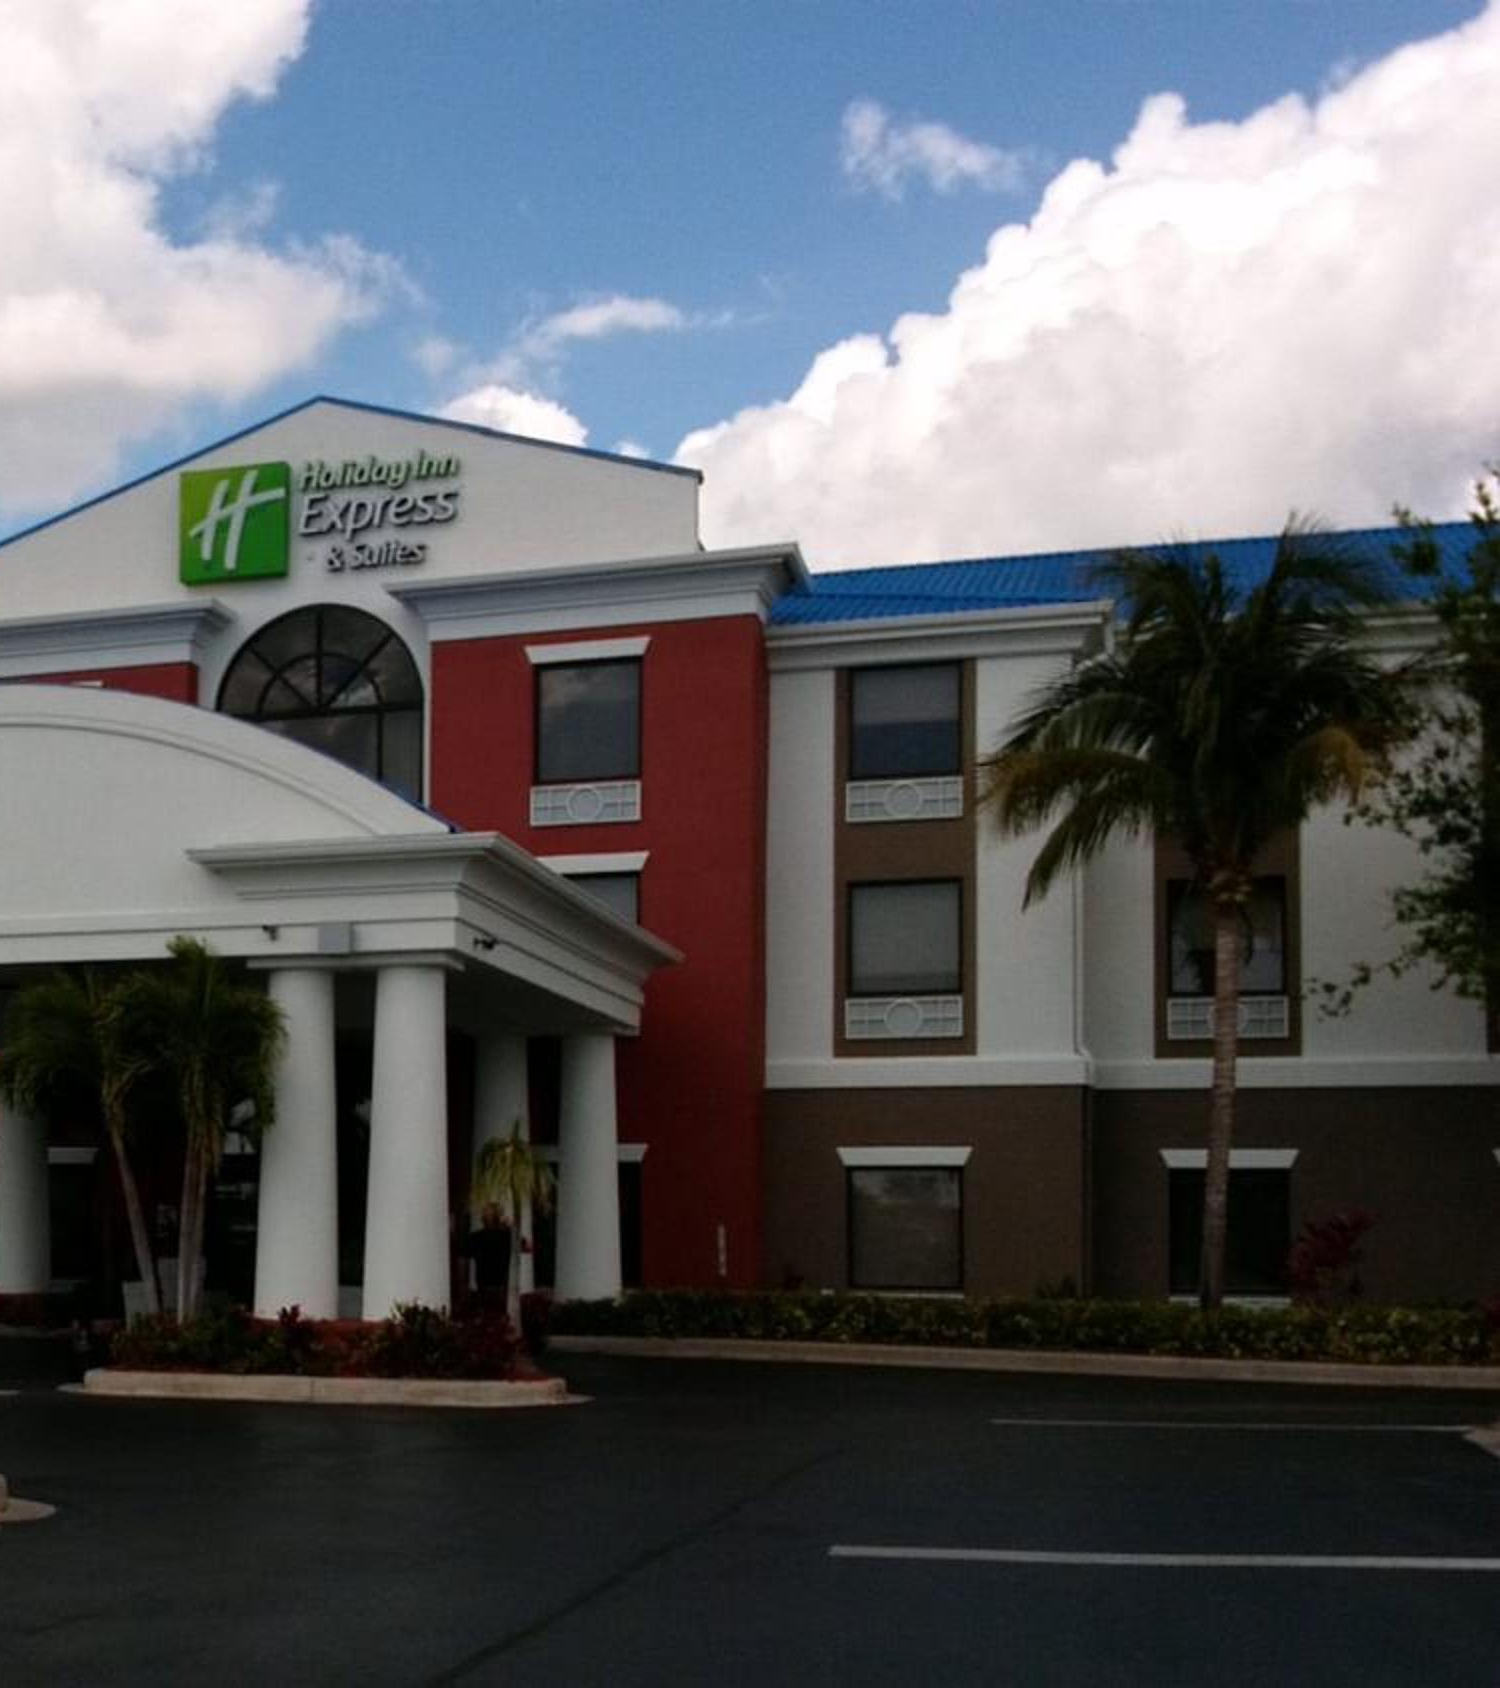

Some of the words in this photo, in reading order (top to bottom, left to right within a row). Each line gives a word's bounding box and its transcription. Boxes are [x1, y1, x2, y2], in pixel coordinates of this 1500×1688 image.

[301, 457, 409, 491] Holiday
[414, 450, 459, 480] Inn
[300, 492, 457, 541] Express
[327, 547, 345, 572] &
[350, 541, 425, 570] Suites
